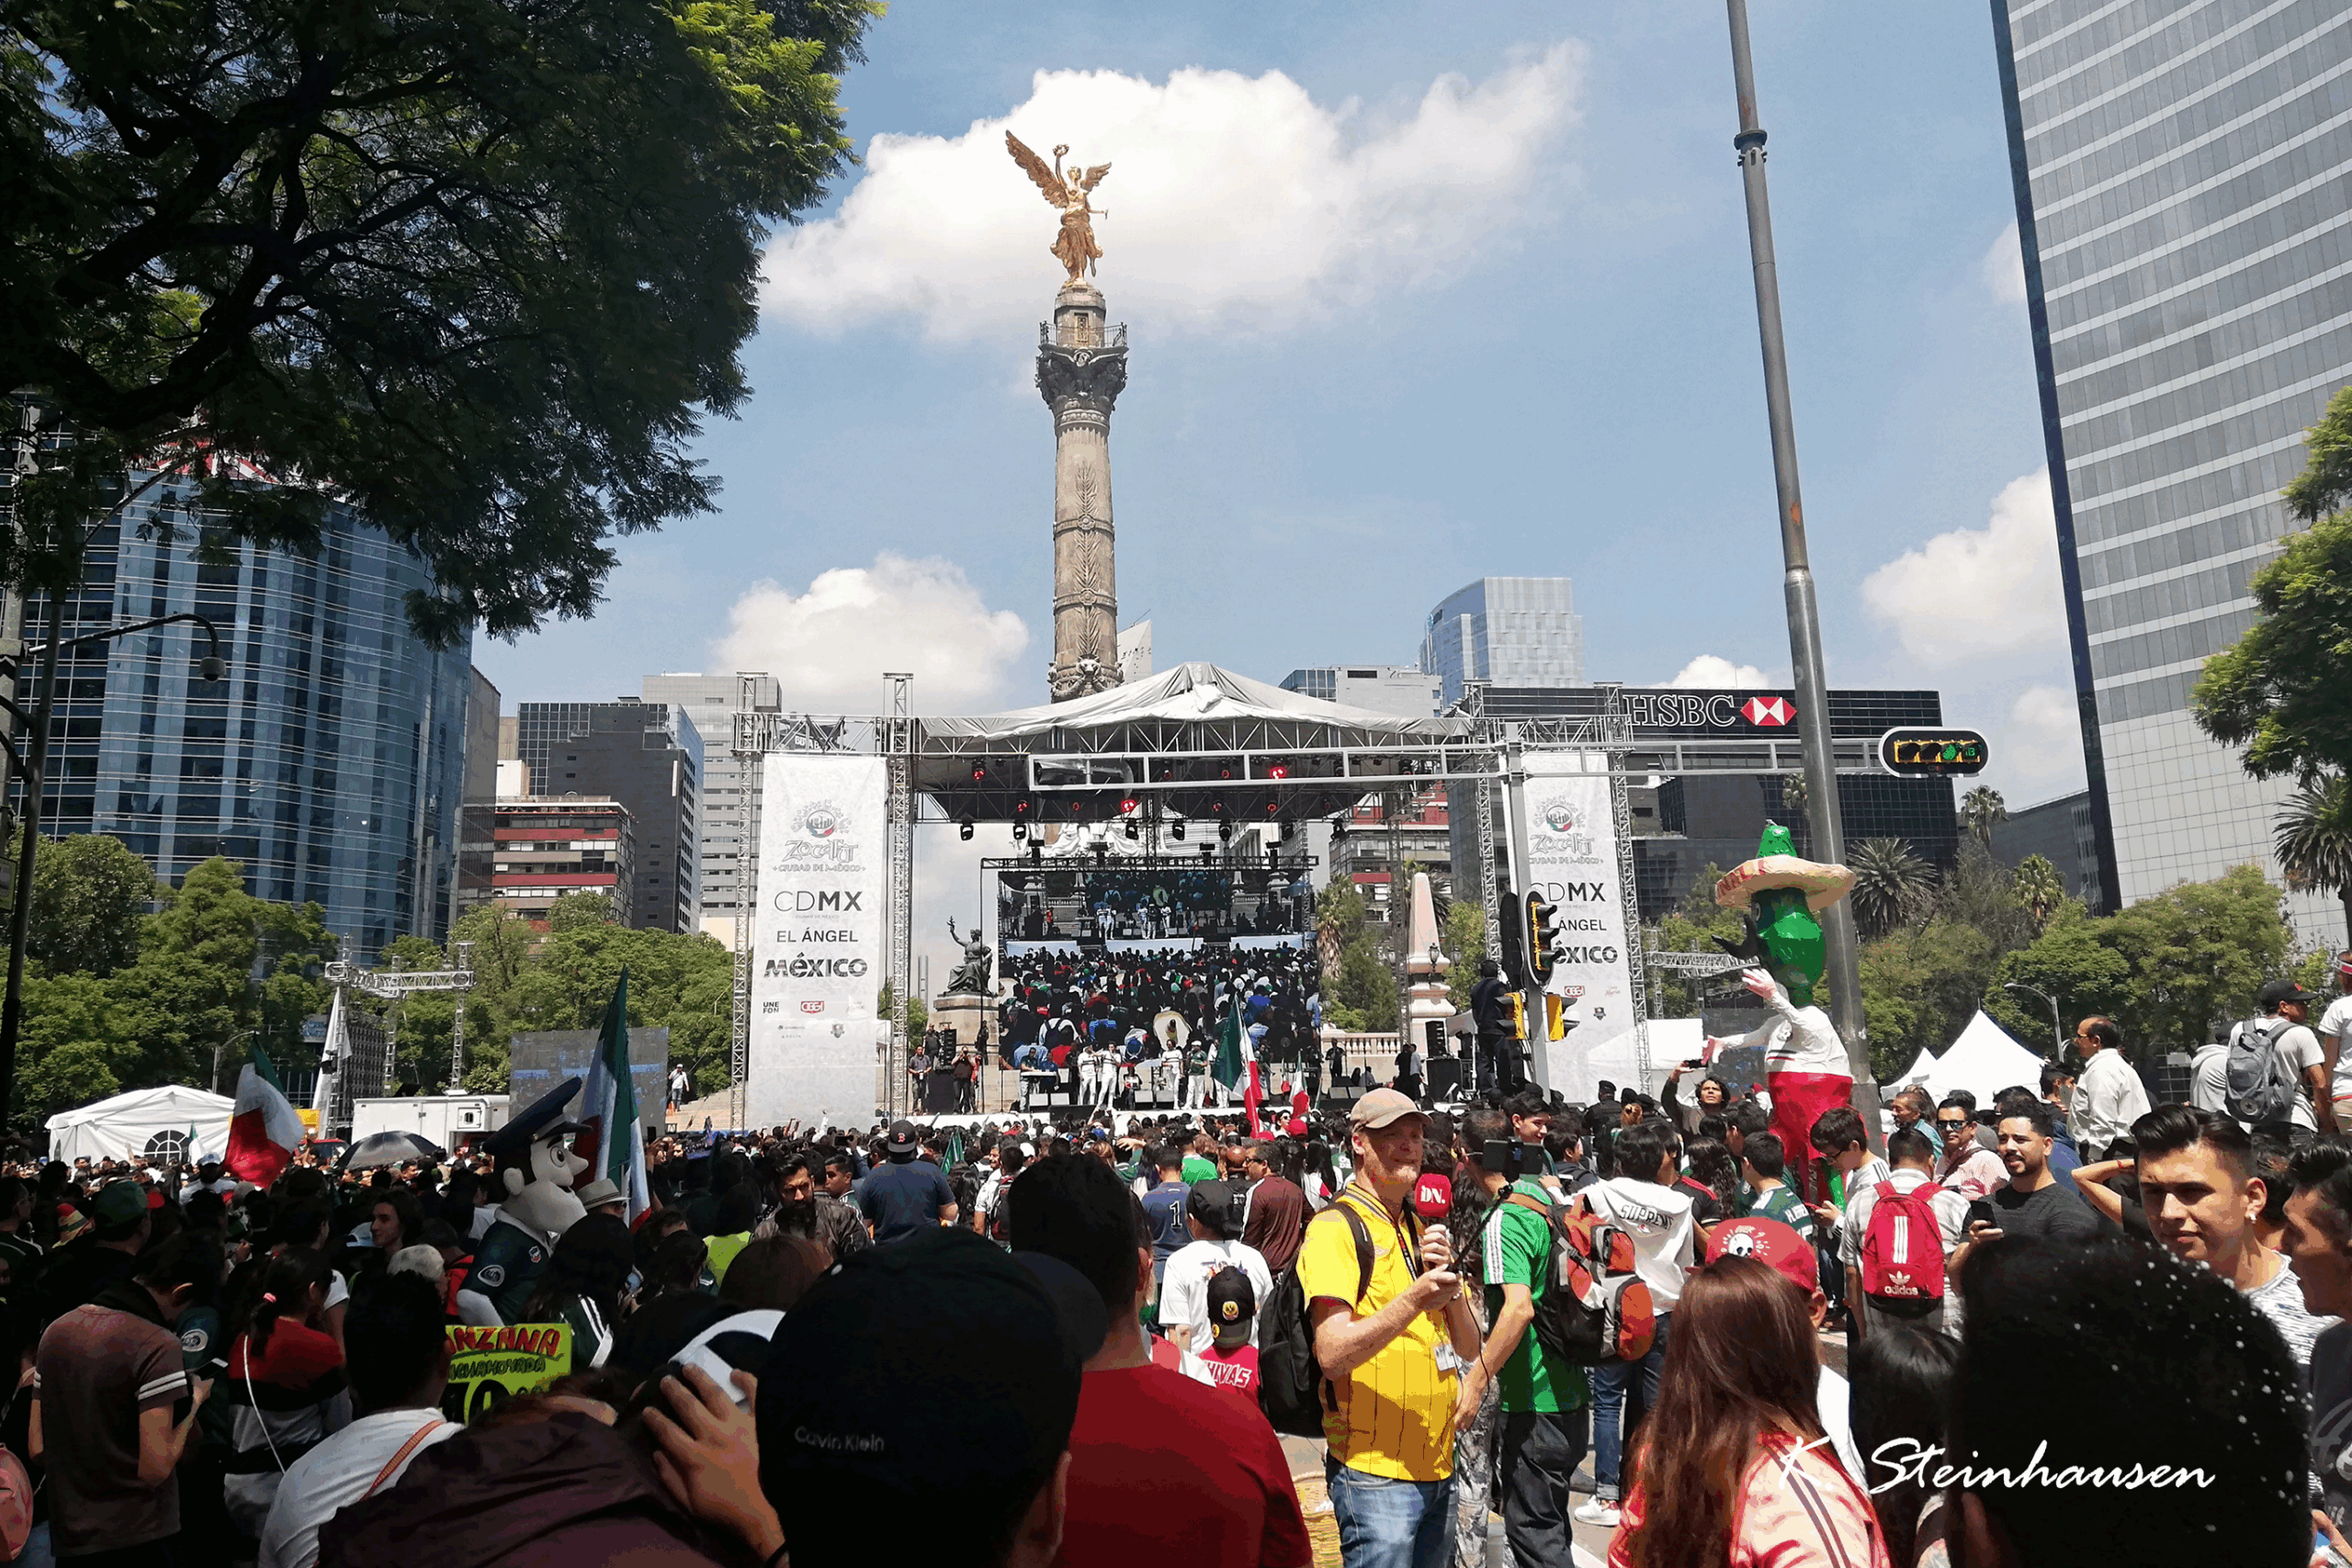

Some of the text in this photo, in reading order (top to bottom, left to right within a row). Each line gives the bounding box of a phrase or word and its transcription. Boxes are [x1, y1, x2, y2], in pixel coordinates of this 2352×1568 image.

[1623, 694, 1736, 727] HSBC
[775, 890, 863, 912] CDMX
[1531, 882, 1606, 902] DMX
[1558, 917, 1607, 931] ÁNGEL
[776, 927, 859, 942] EL ÁNGEL
[1169, 1200, 1183, 1229] 1
[1884, 1284, 1919, 1296] adidas
[845, 1433, 885, 1451] Klein
